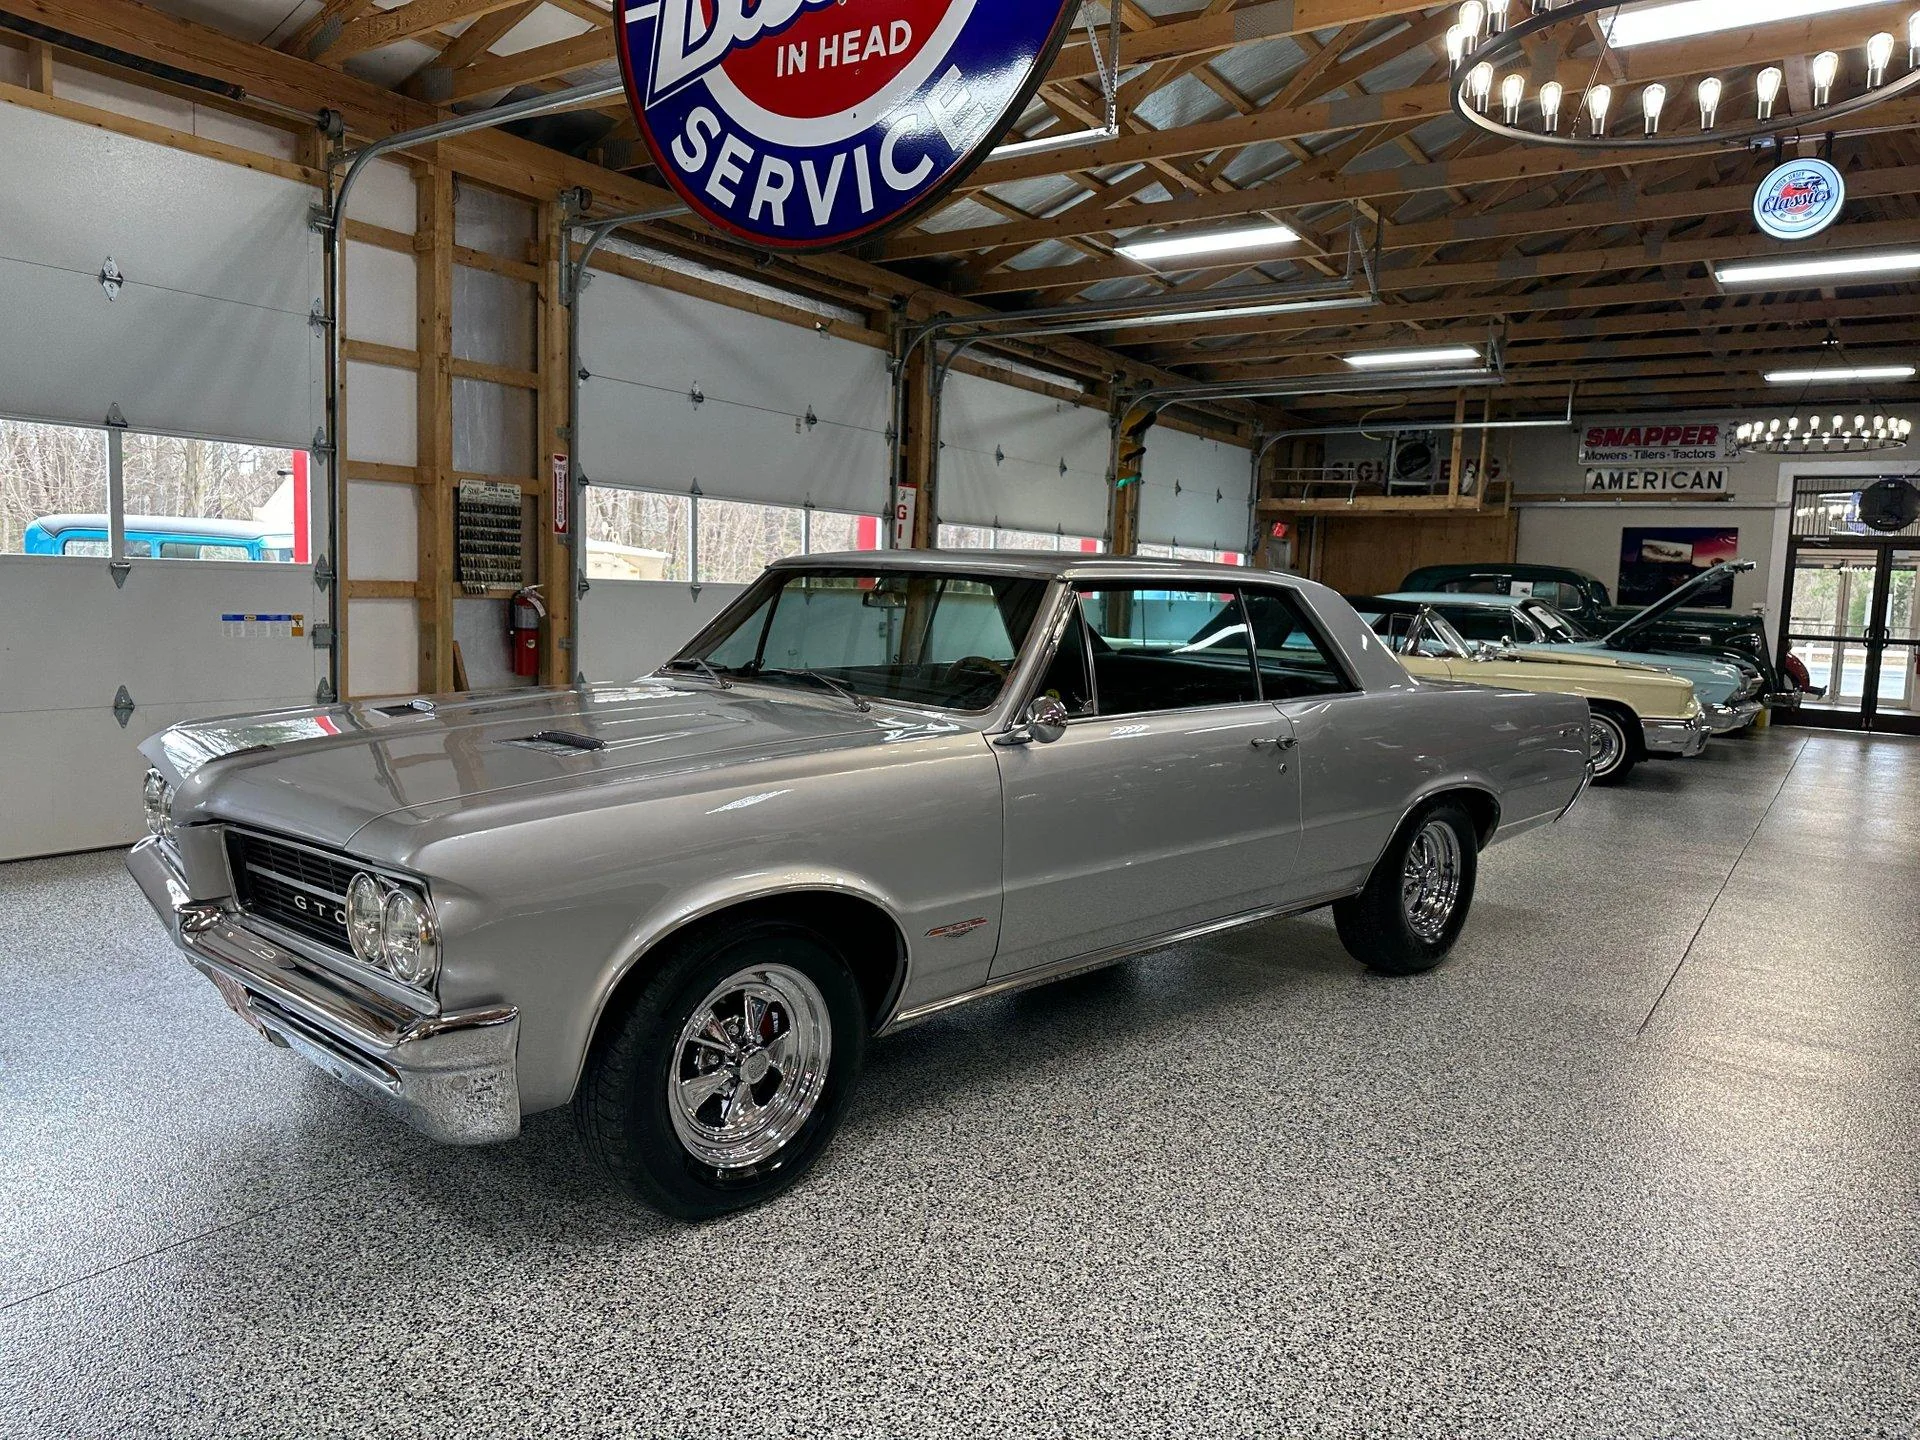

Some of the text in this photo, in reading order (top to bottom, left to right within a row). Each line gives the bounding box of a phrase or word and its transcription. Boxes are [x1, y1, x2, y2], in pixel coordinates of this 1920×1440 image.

[777, 20, 913, 77] IN HEAD
[671, 64, 988, 227] SERVICE
[1762, 187, 1833, 213] Classics
[1585, 425, 1720, 447] SNAPPER
[1585, 449, 1716, 461] Mowers Tillers Tractors
[1592, 471, 1723, 490] AMERICAN
[294, 895, 347, 925] GTO
